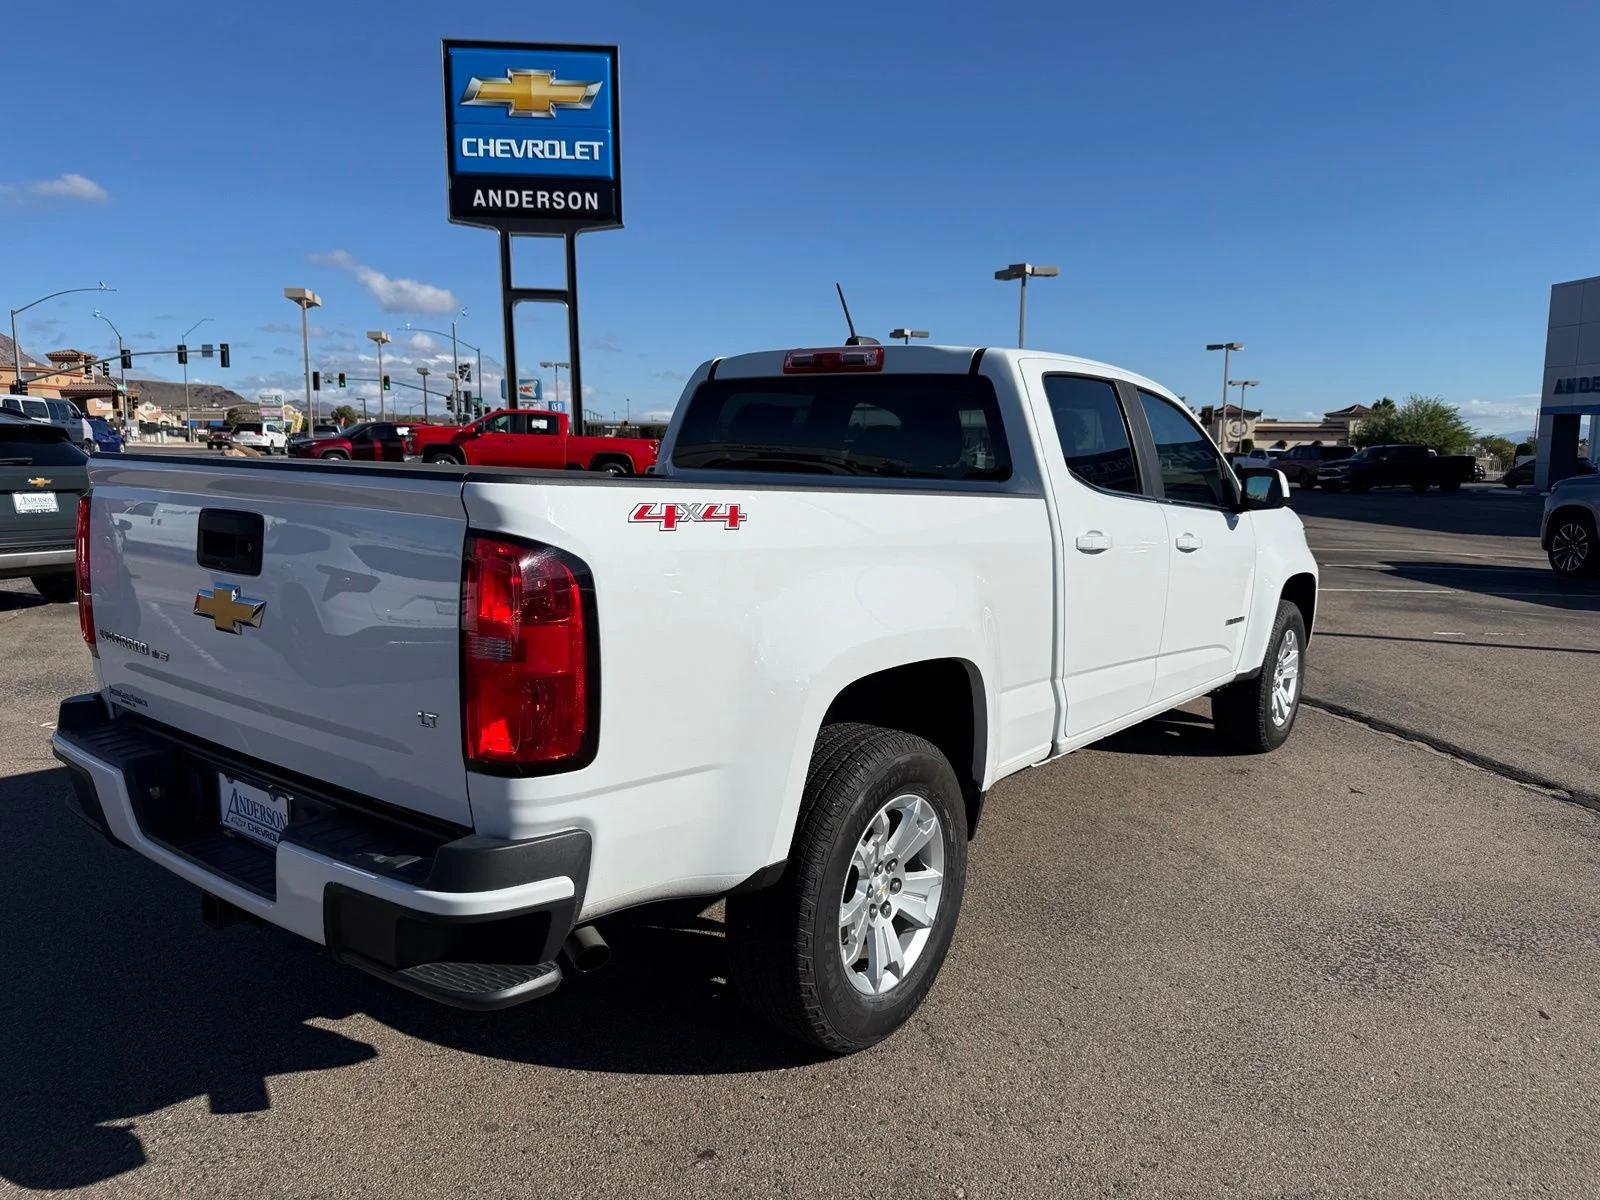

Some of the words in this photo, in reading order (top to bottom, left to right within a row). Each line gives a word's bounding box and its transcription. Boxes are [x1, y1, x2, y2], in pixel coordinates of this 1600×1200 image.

[462, 138, 603, 160] CHEVROLET
[473, 189, 599, 210] ANDERSON
[417, 711, 439, 728] LT
[223, 787, 287, 833] ANDERSON
[247, 821, 281, 844] CHEVROL
